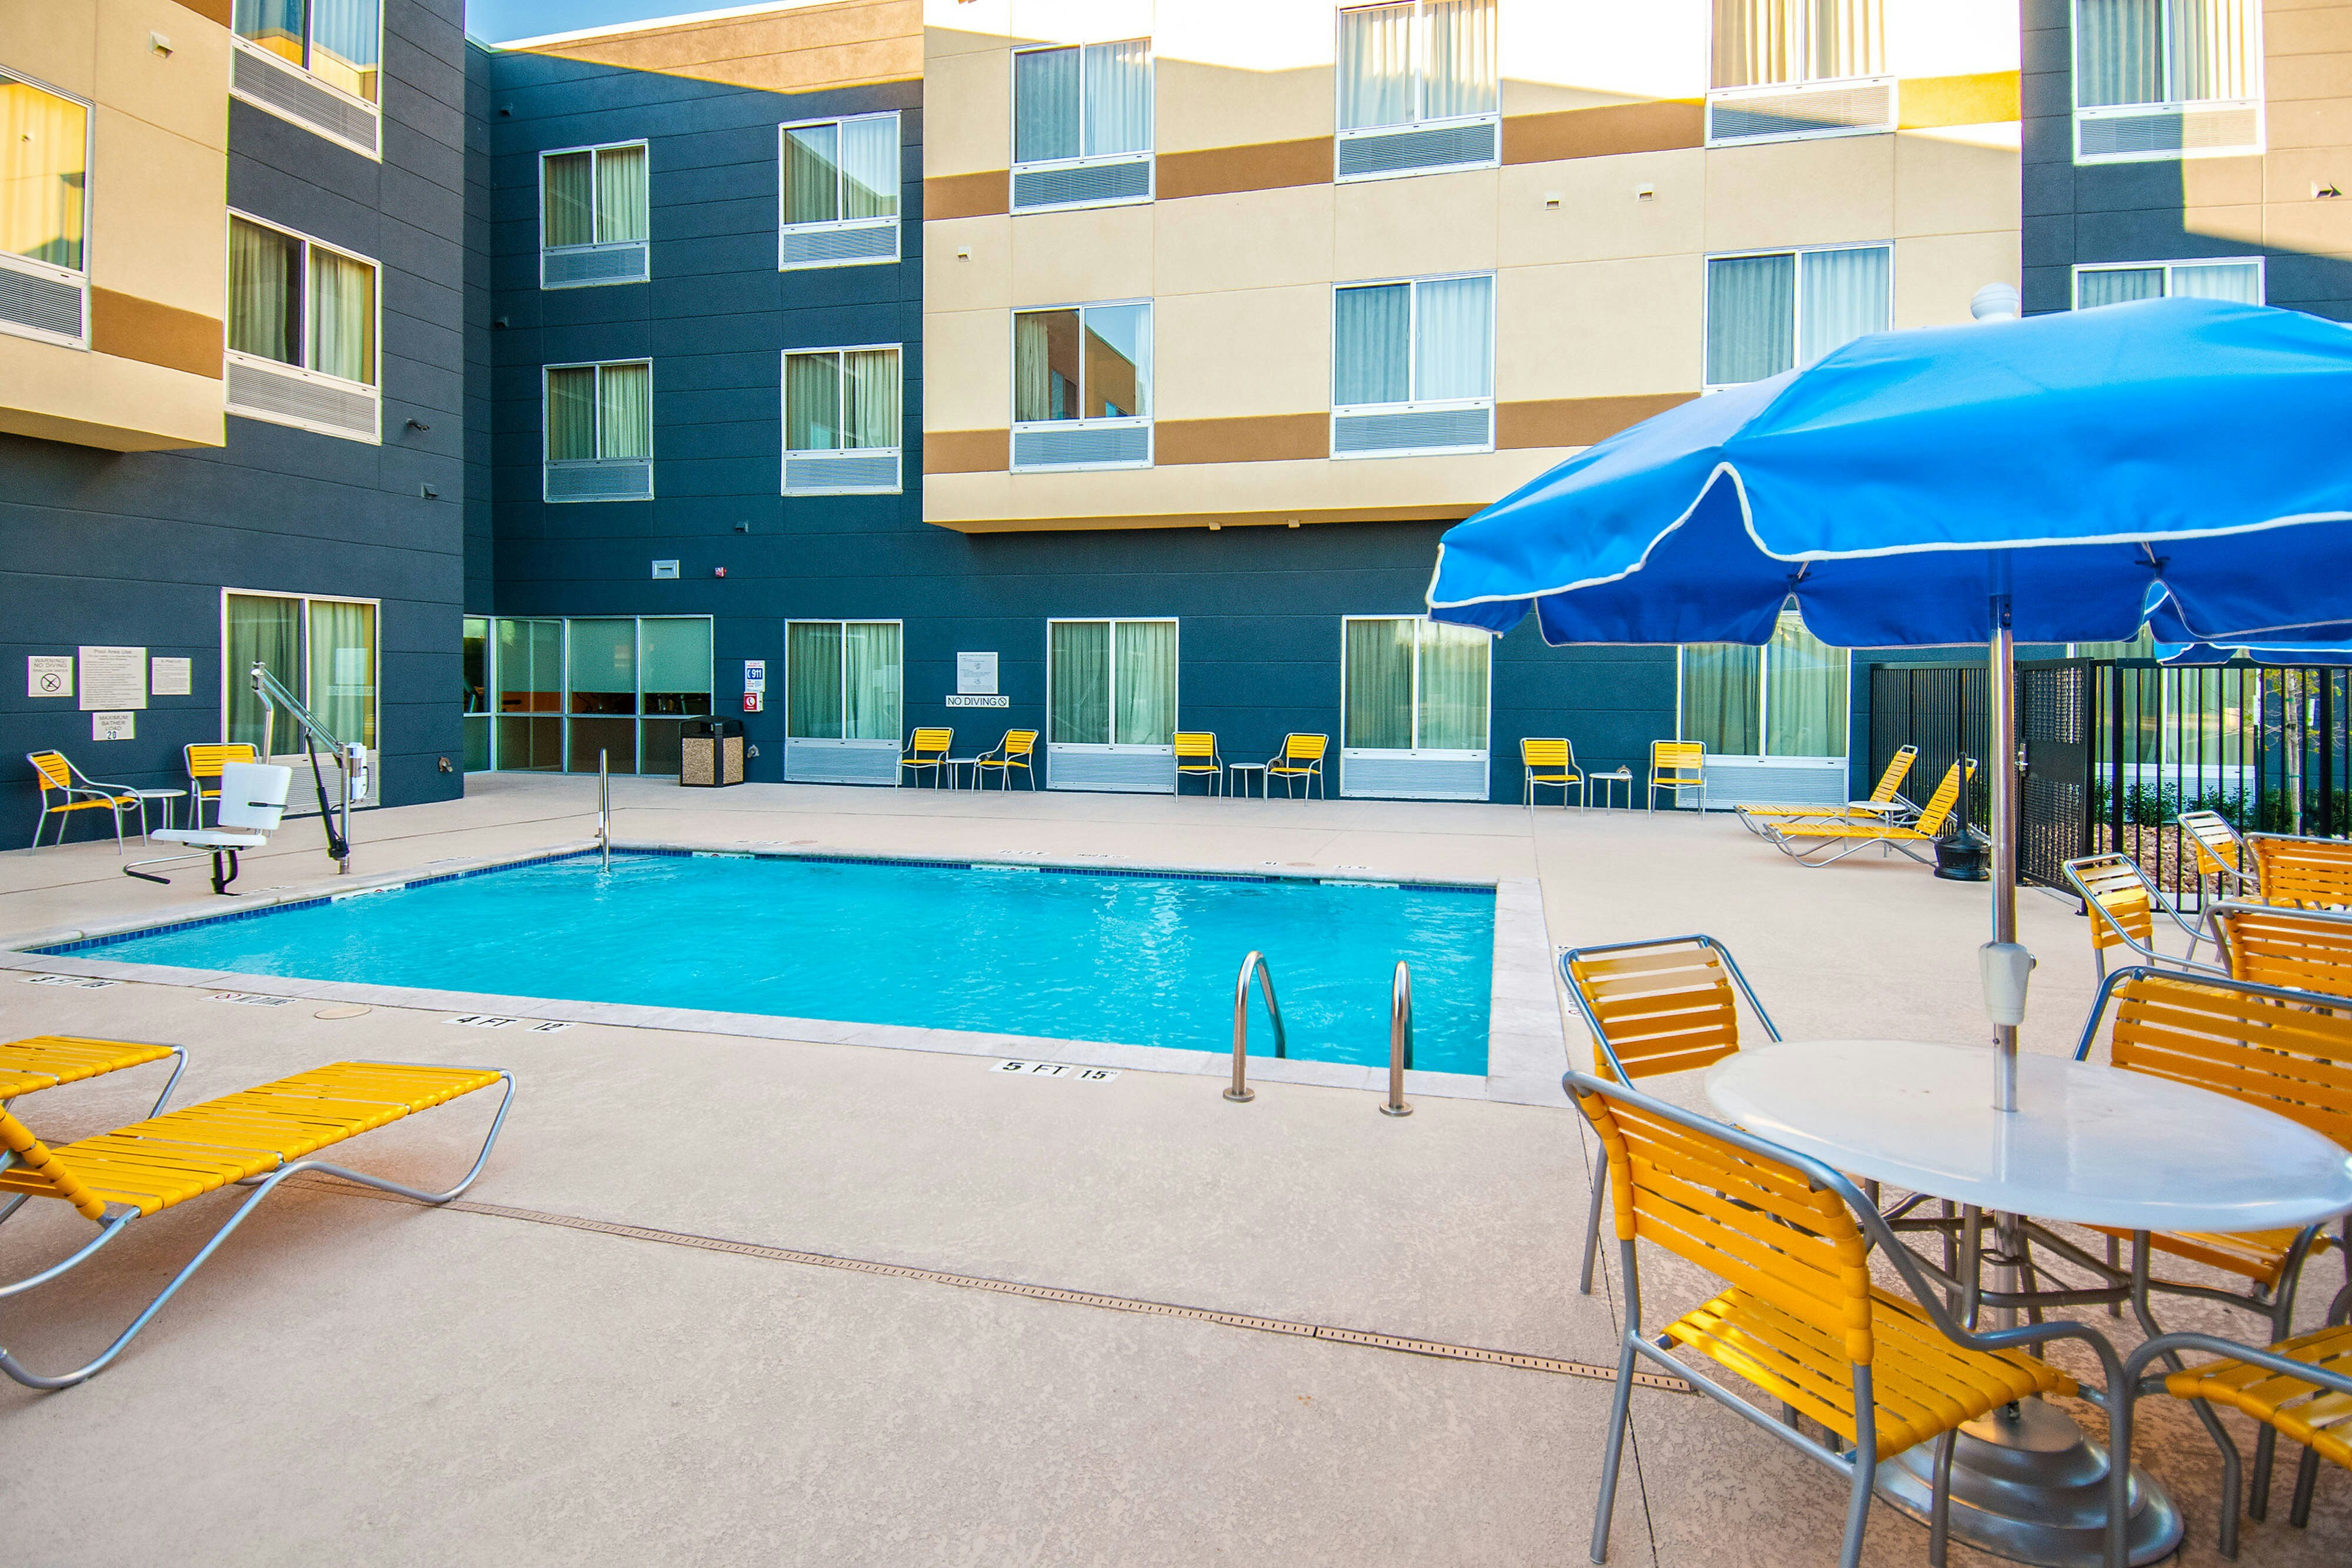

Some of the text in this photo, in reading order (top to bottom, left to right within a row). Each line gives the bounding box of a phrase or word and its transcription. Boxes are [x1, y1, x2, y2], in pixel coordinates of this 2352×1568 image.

[751, 668, 762, 678] 911
[948, 697, 997, 706] NO DIVING
[108, 731, 117, 739] 20
[477, 1017, 517, 1027] FT
[1002, 1062, 1025, 1071] 5
[1031, 1064, 1070, 1075] FT
